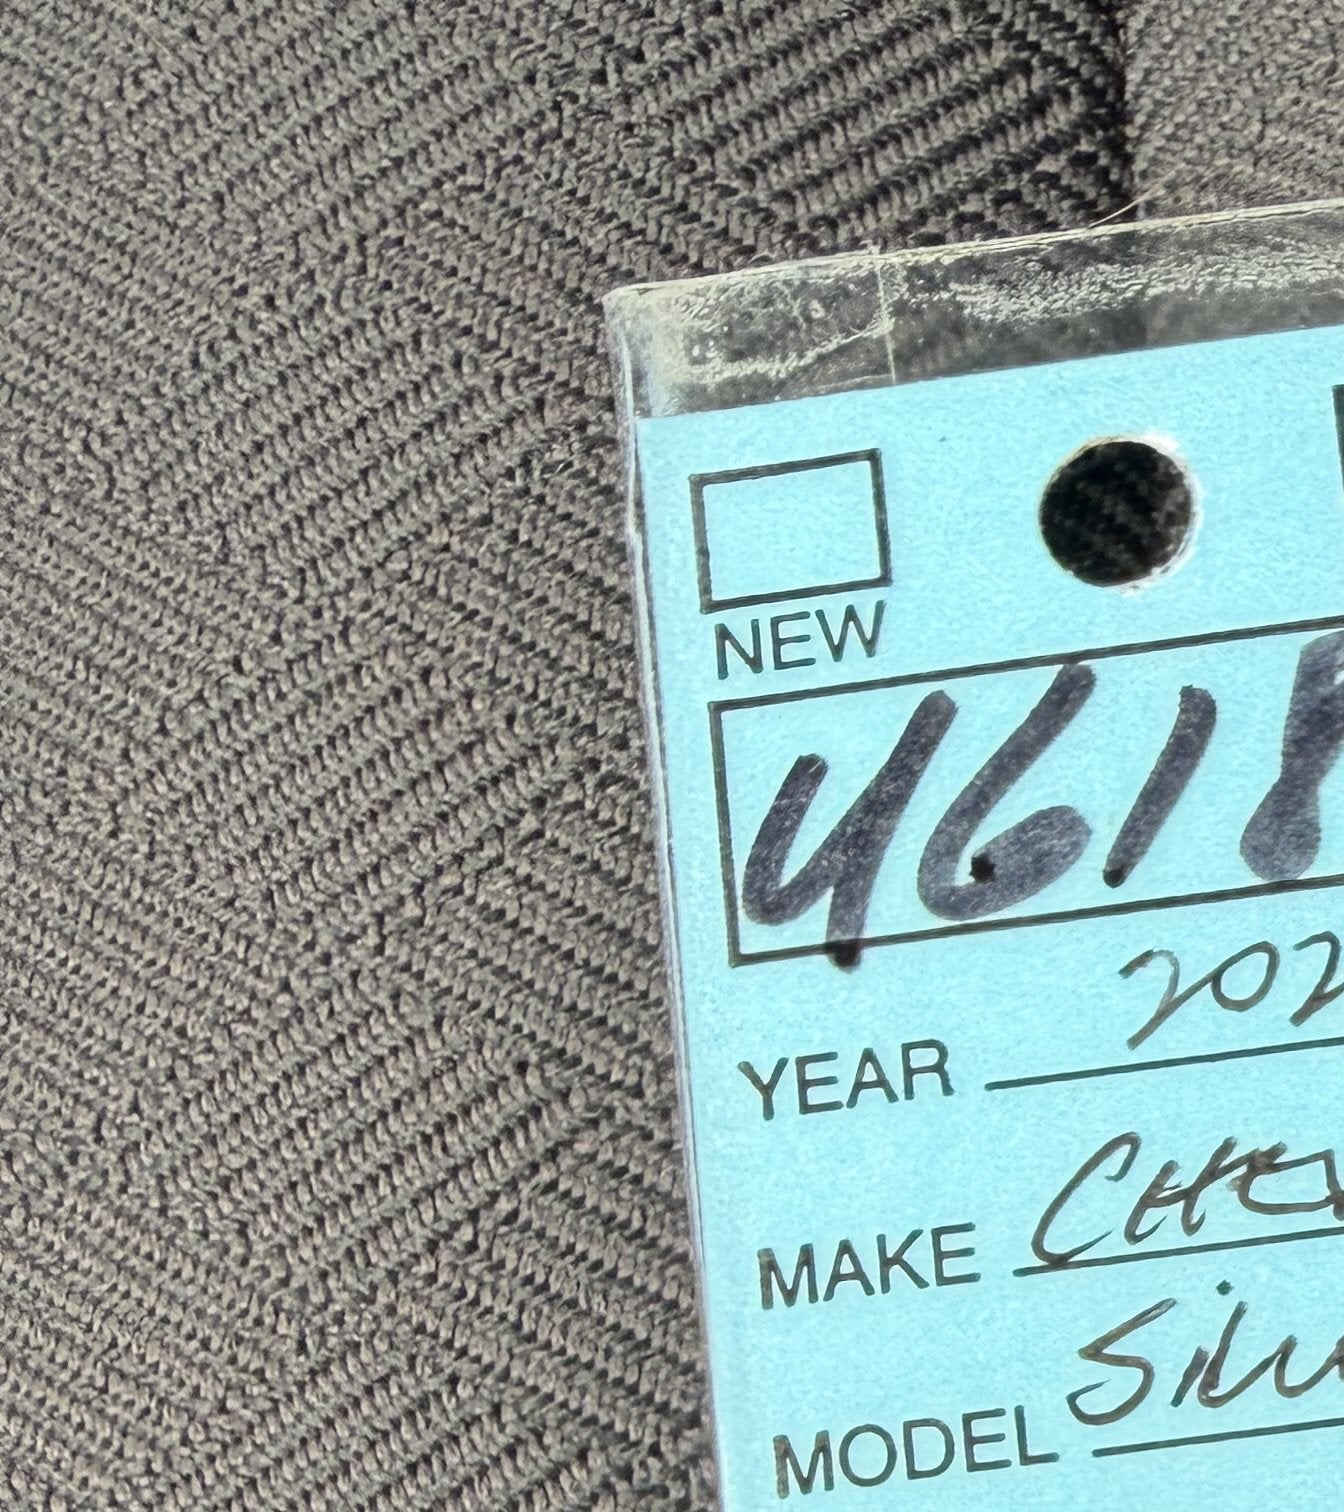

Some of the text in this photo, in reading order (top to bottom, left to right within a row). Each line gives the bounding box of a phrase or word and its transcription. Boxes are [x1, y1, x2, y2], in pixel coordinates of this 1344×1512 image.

[715, 601, 887, 679] NEW
[737, 1038, 956, 1120] YEAR
[757, 1223, 981, 1310] MAKE
[772, 1405, 1059, 1499] MODEL
